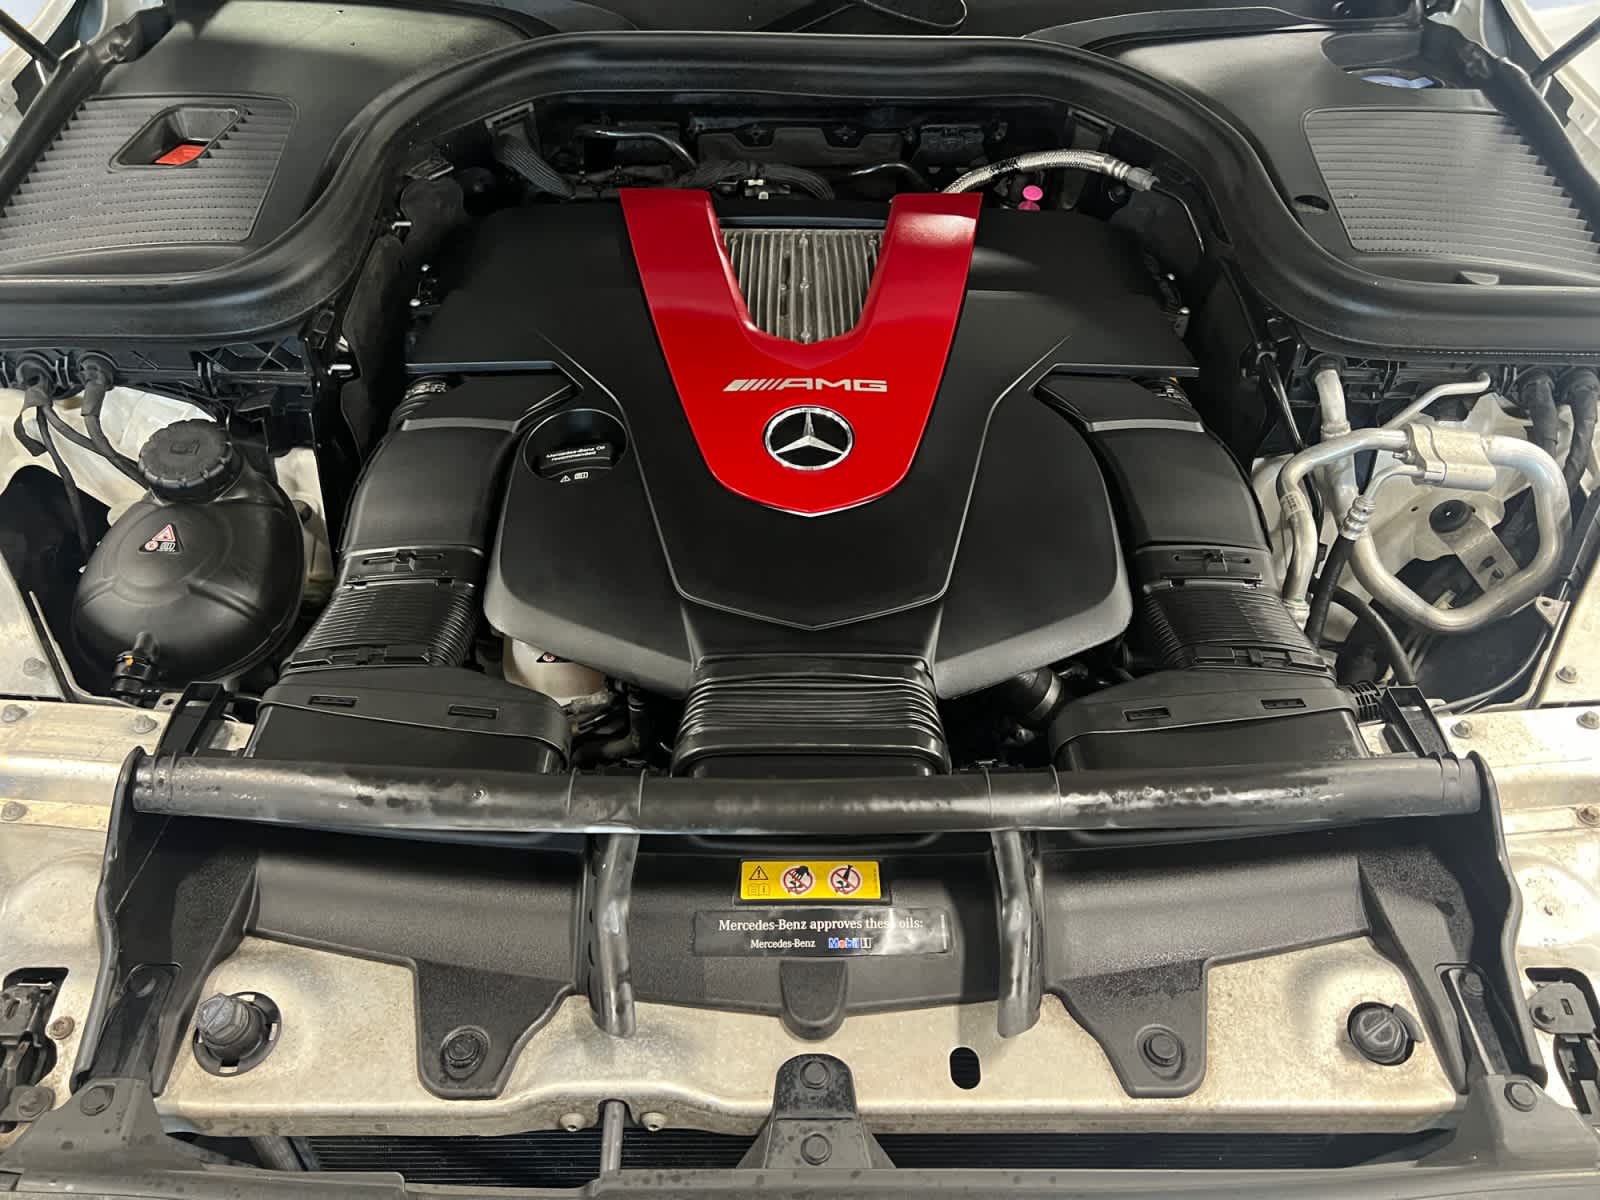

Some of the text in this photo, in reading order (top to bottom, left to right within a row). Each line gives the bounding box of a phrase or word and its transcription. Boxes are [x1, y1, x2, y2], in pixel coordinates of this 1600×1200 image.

[776, 378, 887, 392] AMG
[718, 917, 924, 932] Mercedes-Benz approves thes oils:
[750, 938, 816, 949] Mercedes-Benz
[828, 937, 861, 949] Mobil
